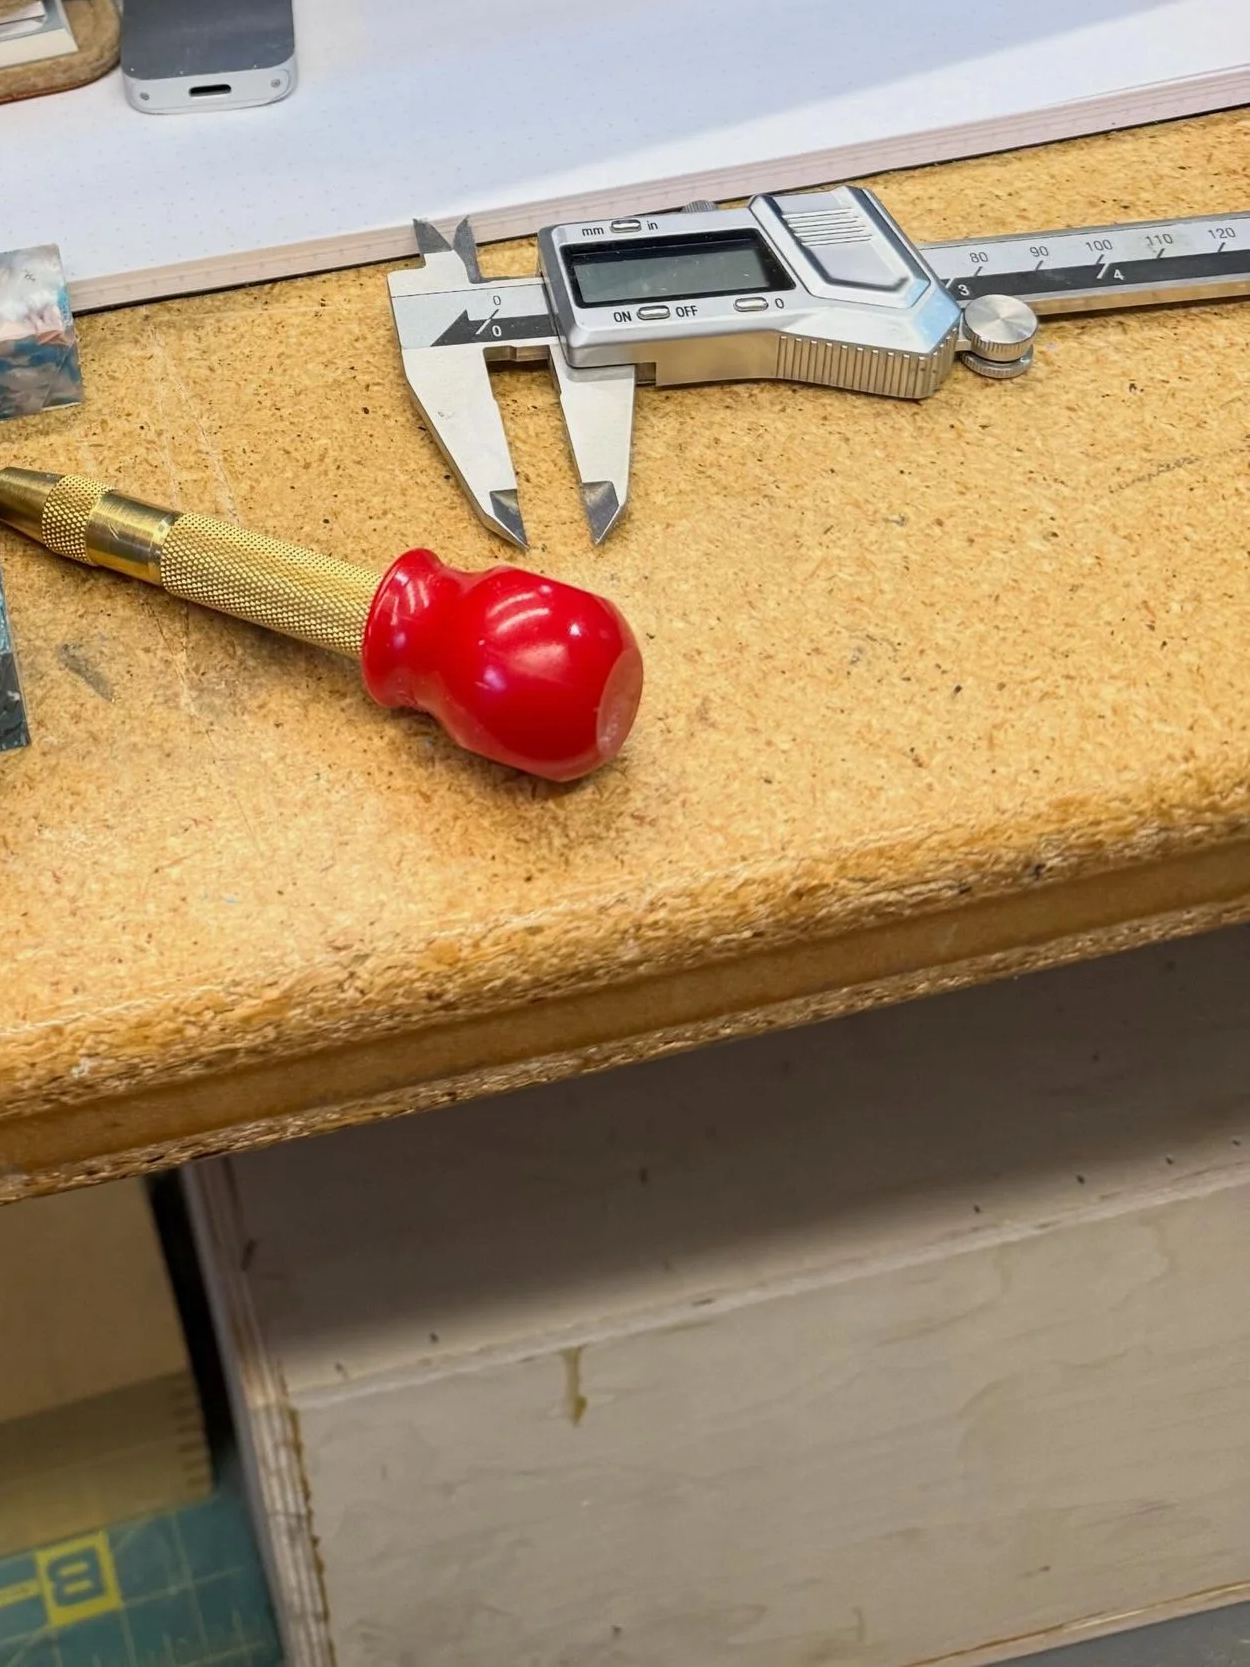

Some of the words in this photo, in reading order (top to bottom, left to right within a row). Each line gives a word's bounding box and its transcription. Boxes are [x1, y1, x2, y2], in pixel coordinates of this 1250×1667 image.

[581, 225, 605, 237] mm
[646, 220, 659, 231] in
[969, 251, 989, 264] 80
[1029, 245, 1050, 257] 90
[1085, 239, 1113, 252] 100
[1146, 233, 1174, 246] 110
[1207, 227, 1236, 240] 120
[957, 283, 970, 296] 3
[1112, 269, 1125, 281] 4
[492, 295, 502, 307] 0
[613, 310, 632, 323] ON
[675, 305, 699, 319] OFF
[491, 325, 503, 338] 0
